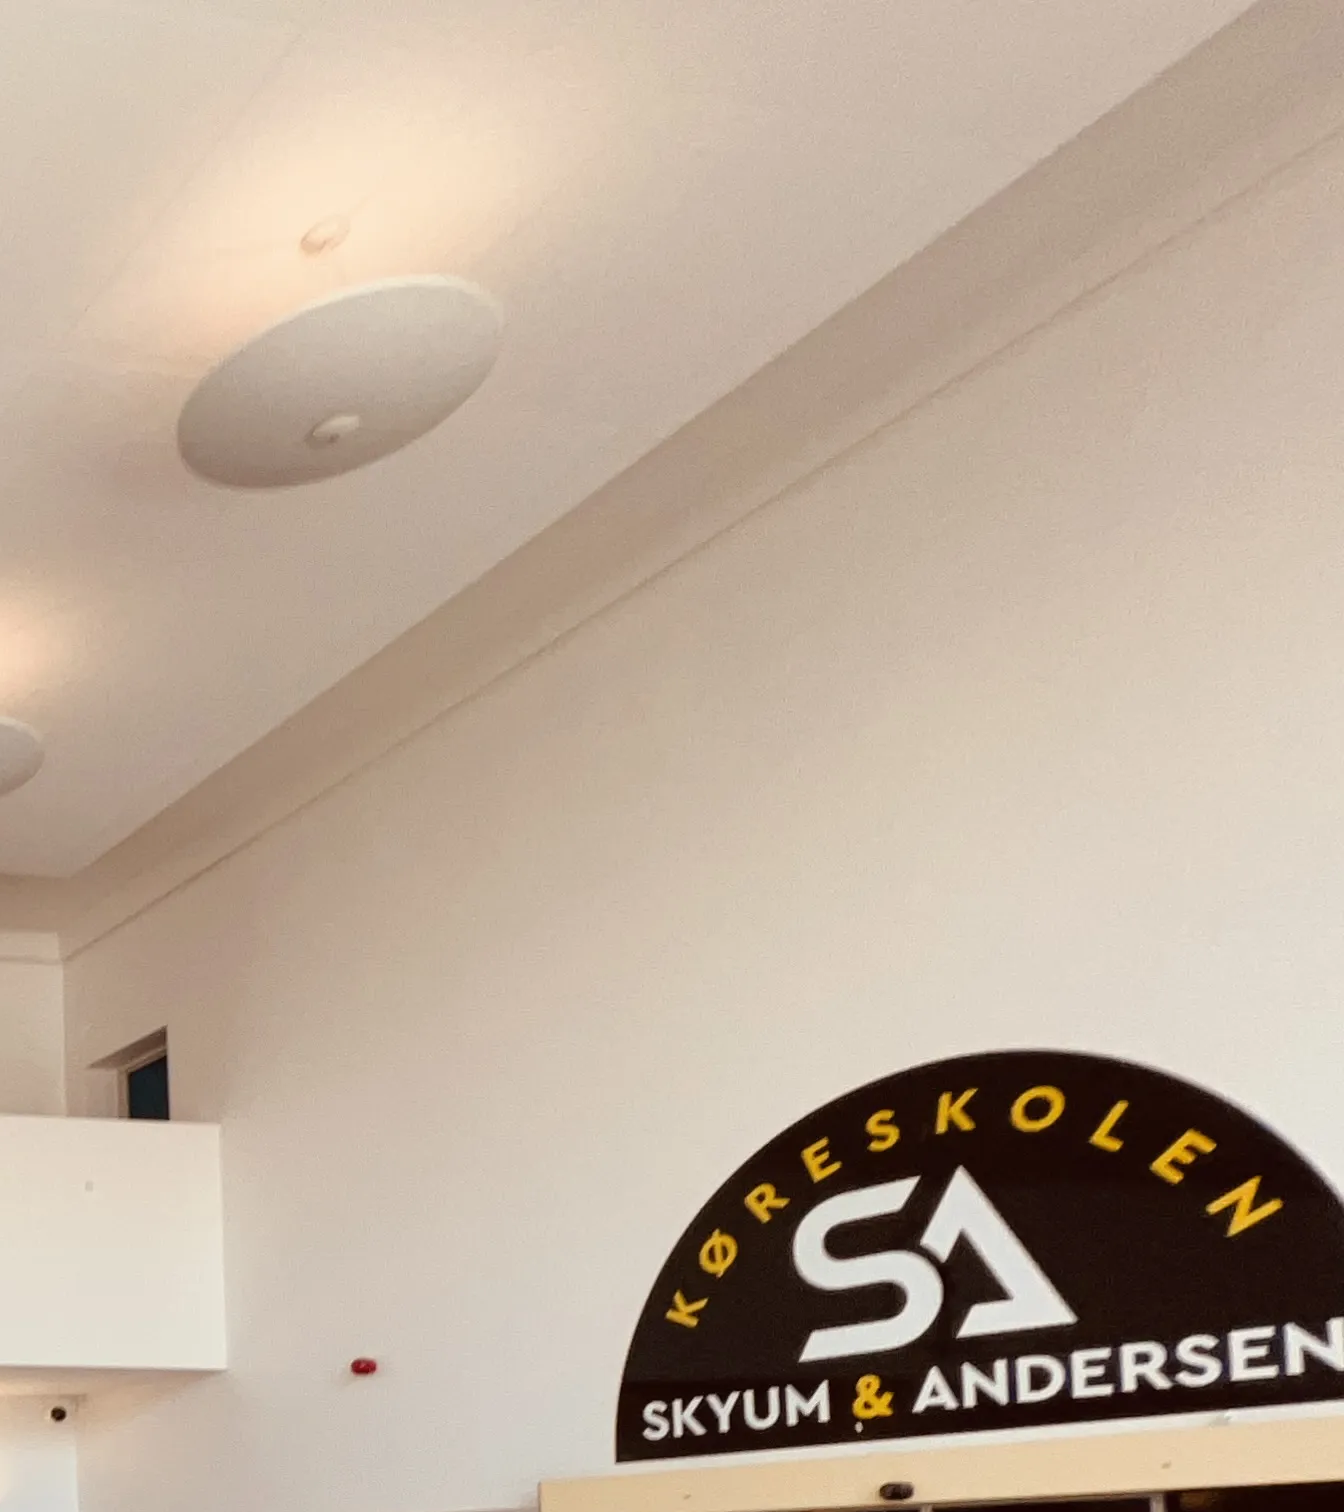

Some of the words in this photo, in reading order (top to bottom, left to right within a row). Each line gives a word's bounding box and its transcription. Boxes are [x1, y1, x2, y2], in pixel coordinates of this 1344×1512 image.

[666, 1085, 1282, 1328] KØRESKOLEN
[642, 1379, 831, 1441] SKYUM
[851, 1373, 893, 1419] &
[912, 1316, 1344, 1413] ANDERSEN
